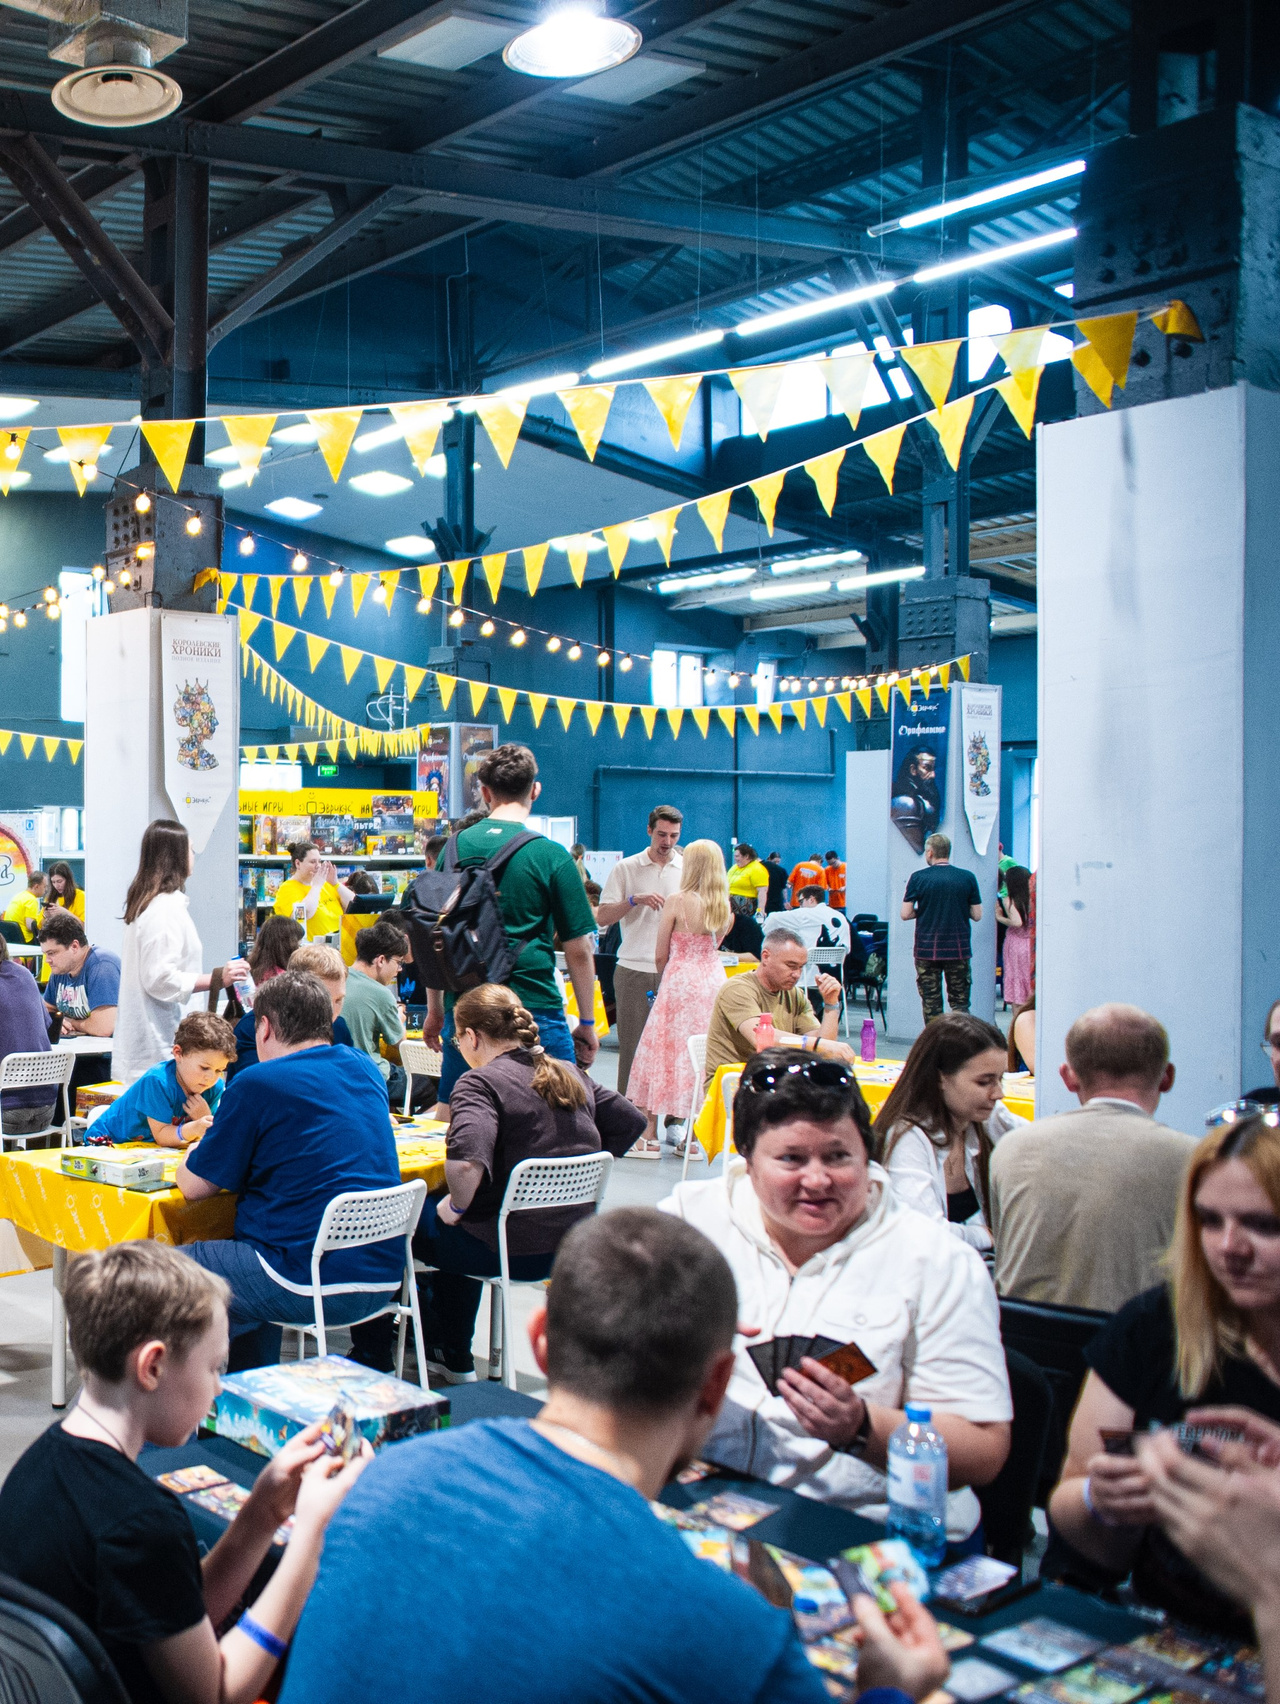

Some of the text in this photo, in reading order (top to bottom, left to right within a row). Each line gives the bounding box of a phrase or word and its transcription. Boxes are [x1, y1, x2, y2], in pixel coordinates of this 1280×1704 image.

[171, 645, 221, 657] ХРОНИКИ
[263, 801, 284, 813] ИГРЫ
[320, 802, 353, 814] Эврикус
